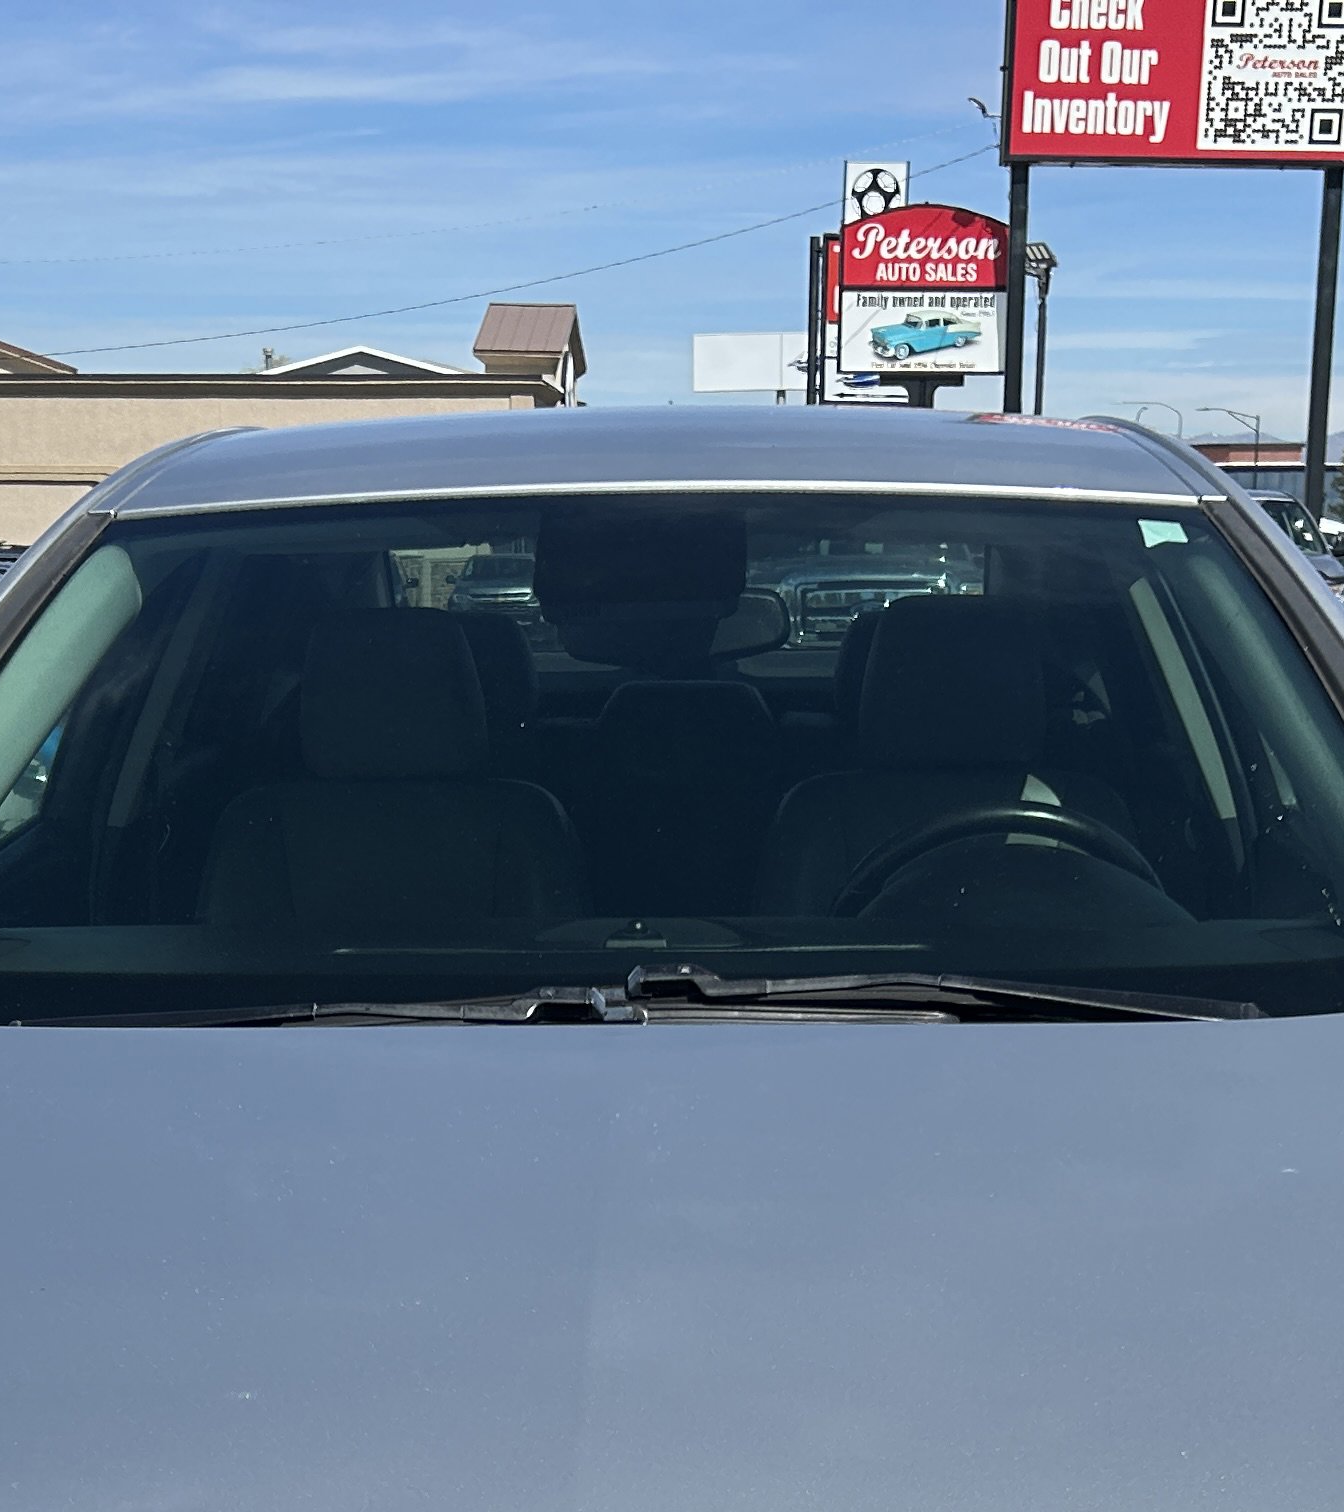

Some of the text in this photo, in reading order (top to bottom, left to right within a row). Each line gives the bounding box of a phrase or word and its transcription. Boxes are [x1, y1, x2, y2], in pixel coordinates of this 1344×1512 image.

[1038, 39, 1159, 85] Out Our
[1236, 52, 1321, 71] Peterson
[1021, 90, 1171, 143] Inventory
[851, 222, 1002, 261] Peterson
[875, 262, 978, 282] AUTO SALES
[856, 293, 889, 310] Family
[928, 294, 946, 309] and
[950, 294, 996, 309] operated
